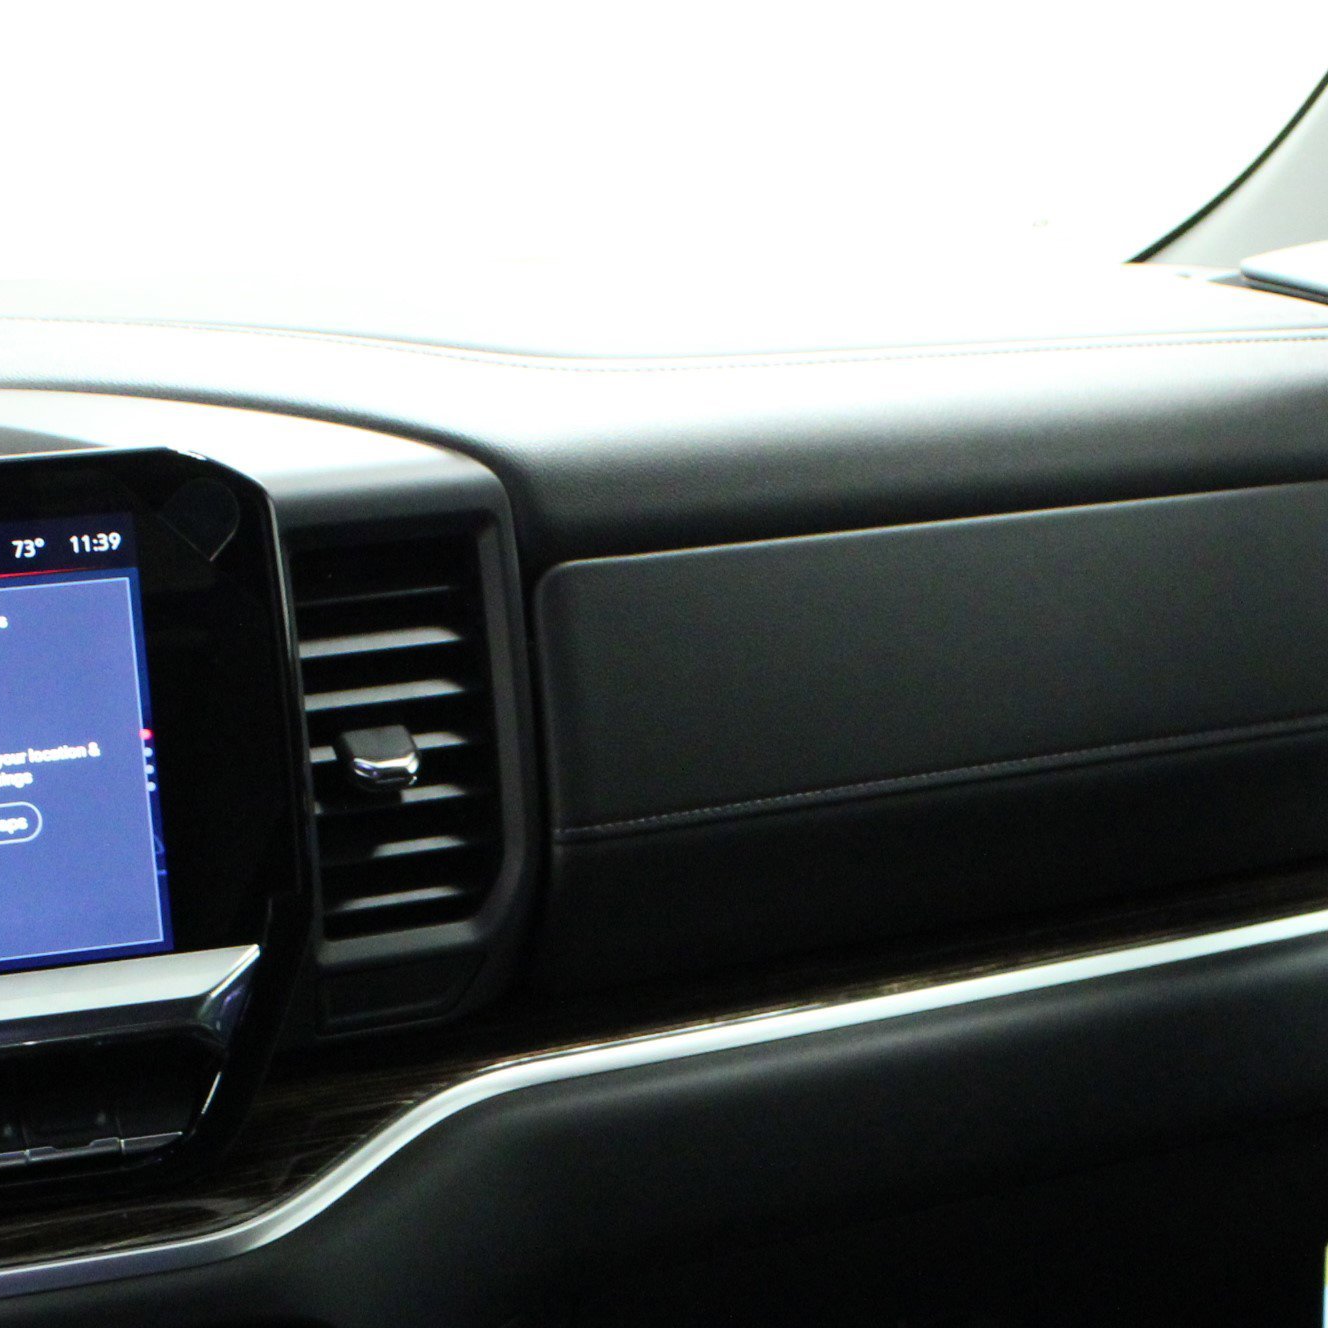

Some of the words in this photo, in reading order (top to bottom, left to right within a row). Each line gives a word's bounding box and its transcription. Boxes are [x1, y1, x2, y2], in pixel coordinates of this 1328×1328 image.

[11, 536, 46, 559] 73°
[69, 531, 122, 554] 11:39
[27, 744, 87, 763] location
[87, 741, 101, 757] &
